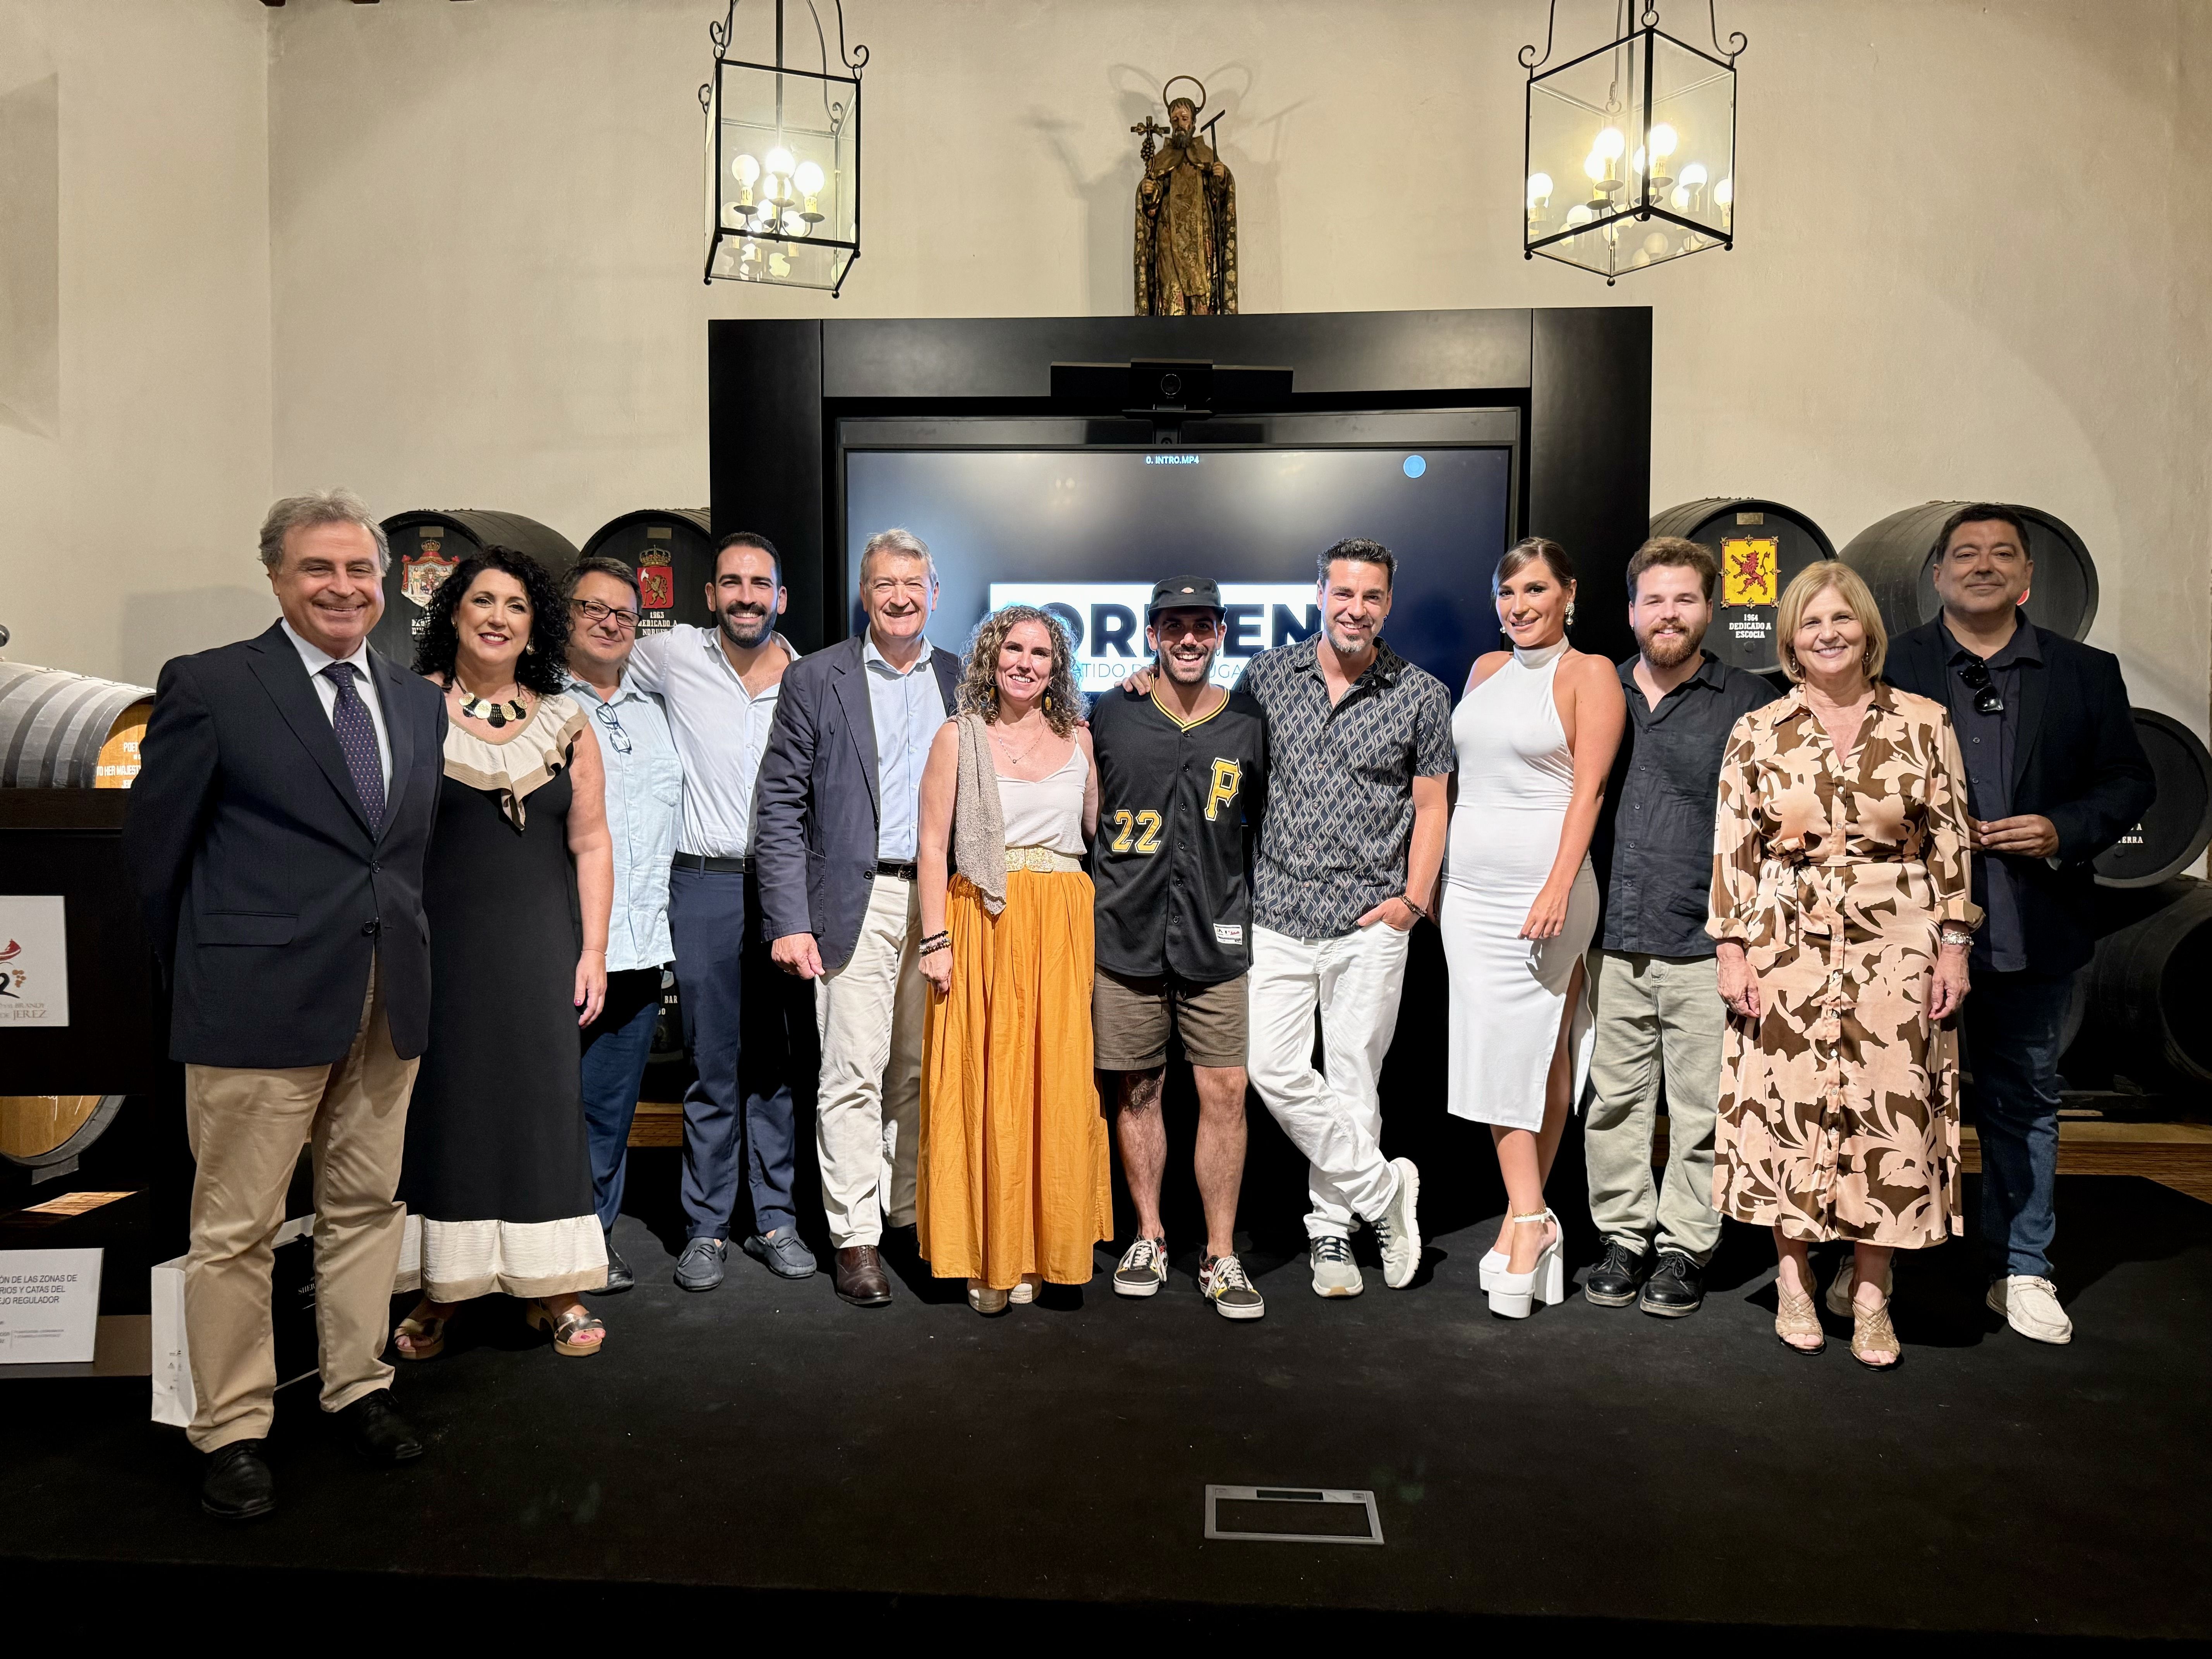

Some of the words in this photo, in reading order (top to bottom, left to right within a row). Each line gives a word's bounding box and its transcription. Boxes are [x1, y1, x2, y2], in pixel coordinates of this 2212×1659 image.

[1146, 456, 1154, 464] 0.
[1155, 455, 1199, 464] INTRO.MP4
[104, 766, 116, 776] HER
[1204, 757, 1242, 821] P
[1112, 809, 1161, 854] 22
[14, 1010, 47, 1020] JEREZ
[13, 1296, 59, 1304] REGULADOR
